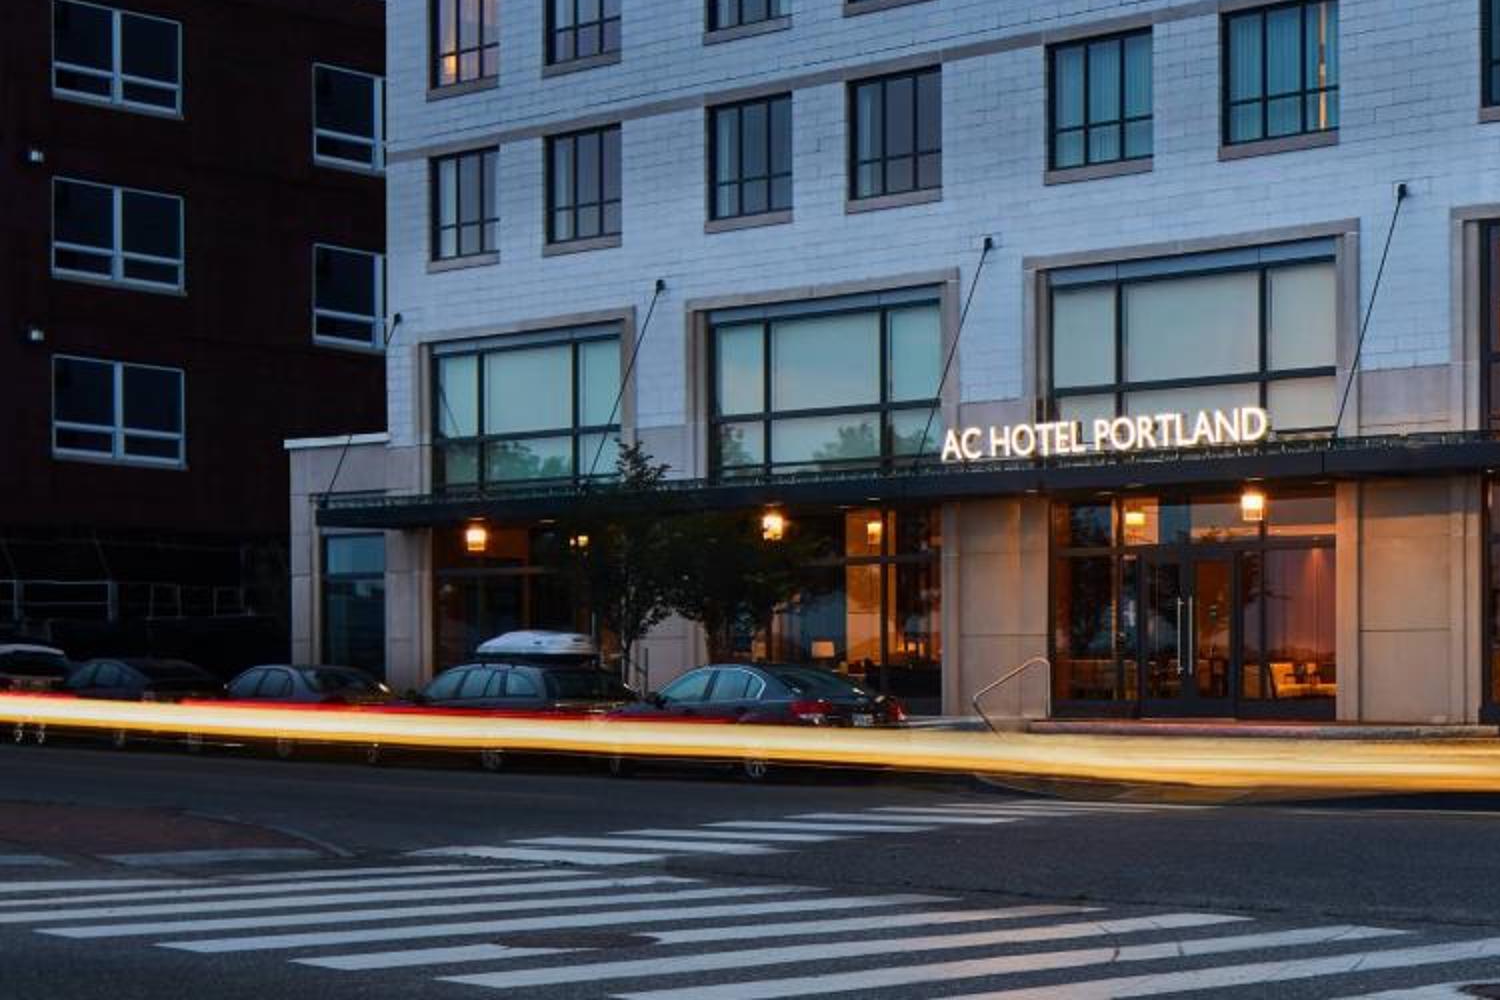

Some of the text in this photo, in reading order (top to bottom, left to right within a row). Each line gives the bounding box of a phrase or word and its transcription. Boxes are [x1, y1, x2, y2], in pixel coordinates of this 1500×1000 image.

[941, 407, 1268, 462] AC HOTEL PORTLAND
